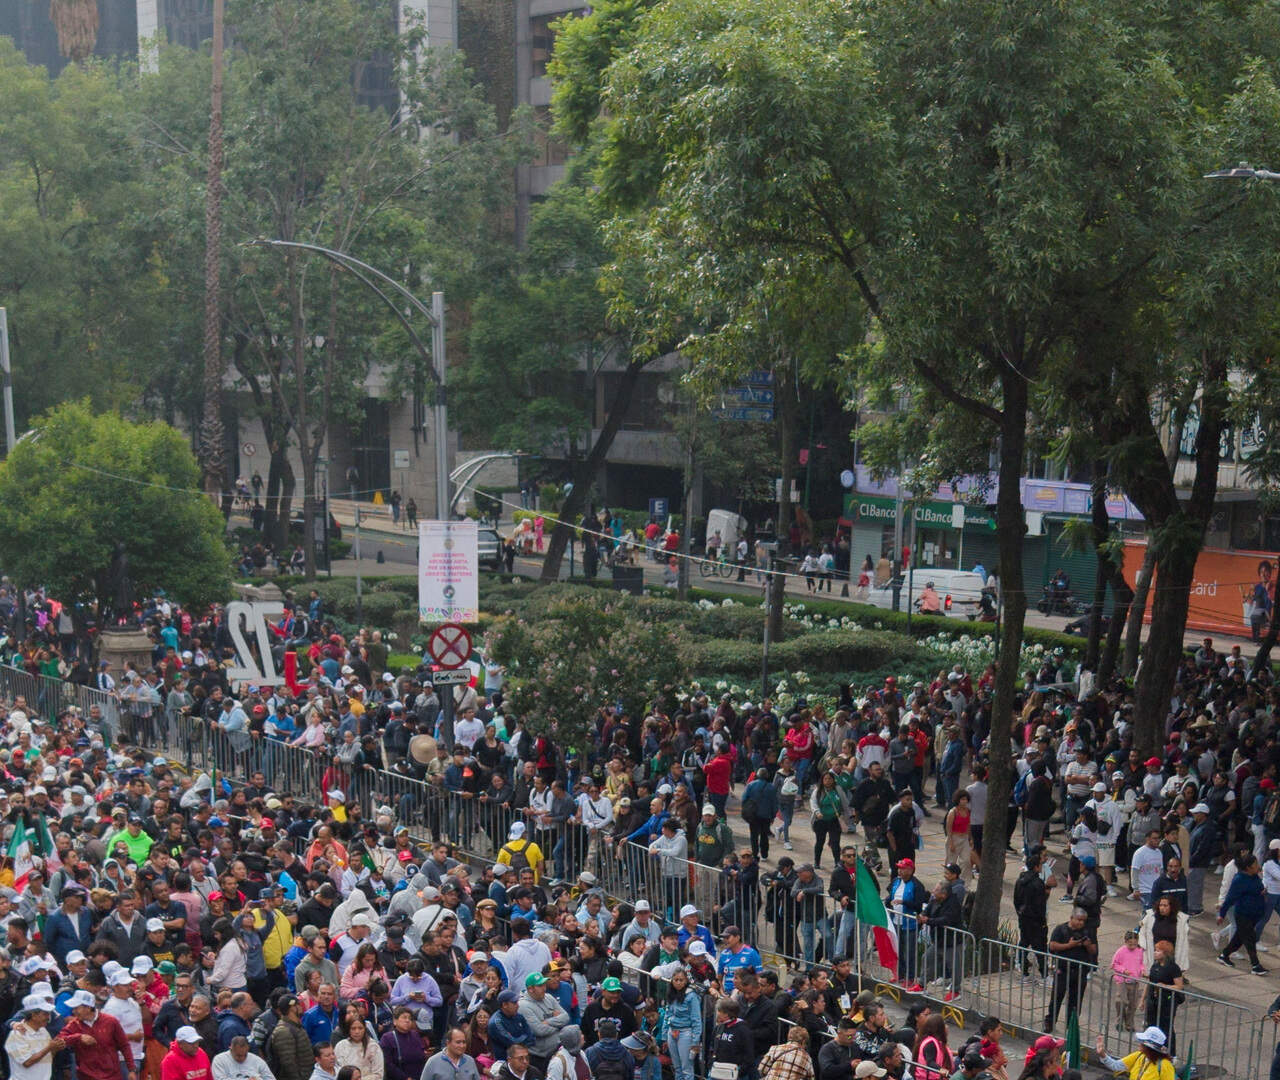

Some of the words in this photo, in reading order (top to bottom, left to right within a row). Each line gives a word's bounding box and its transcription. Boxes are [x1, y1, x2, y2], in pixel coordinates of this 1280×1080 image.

[655, 501, 664, 512] E
[860, 503, 896, 518] CIBanco
[915, 508, 953, 524] CIBanco
